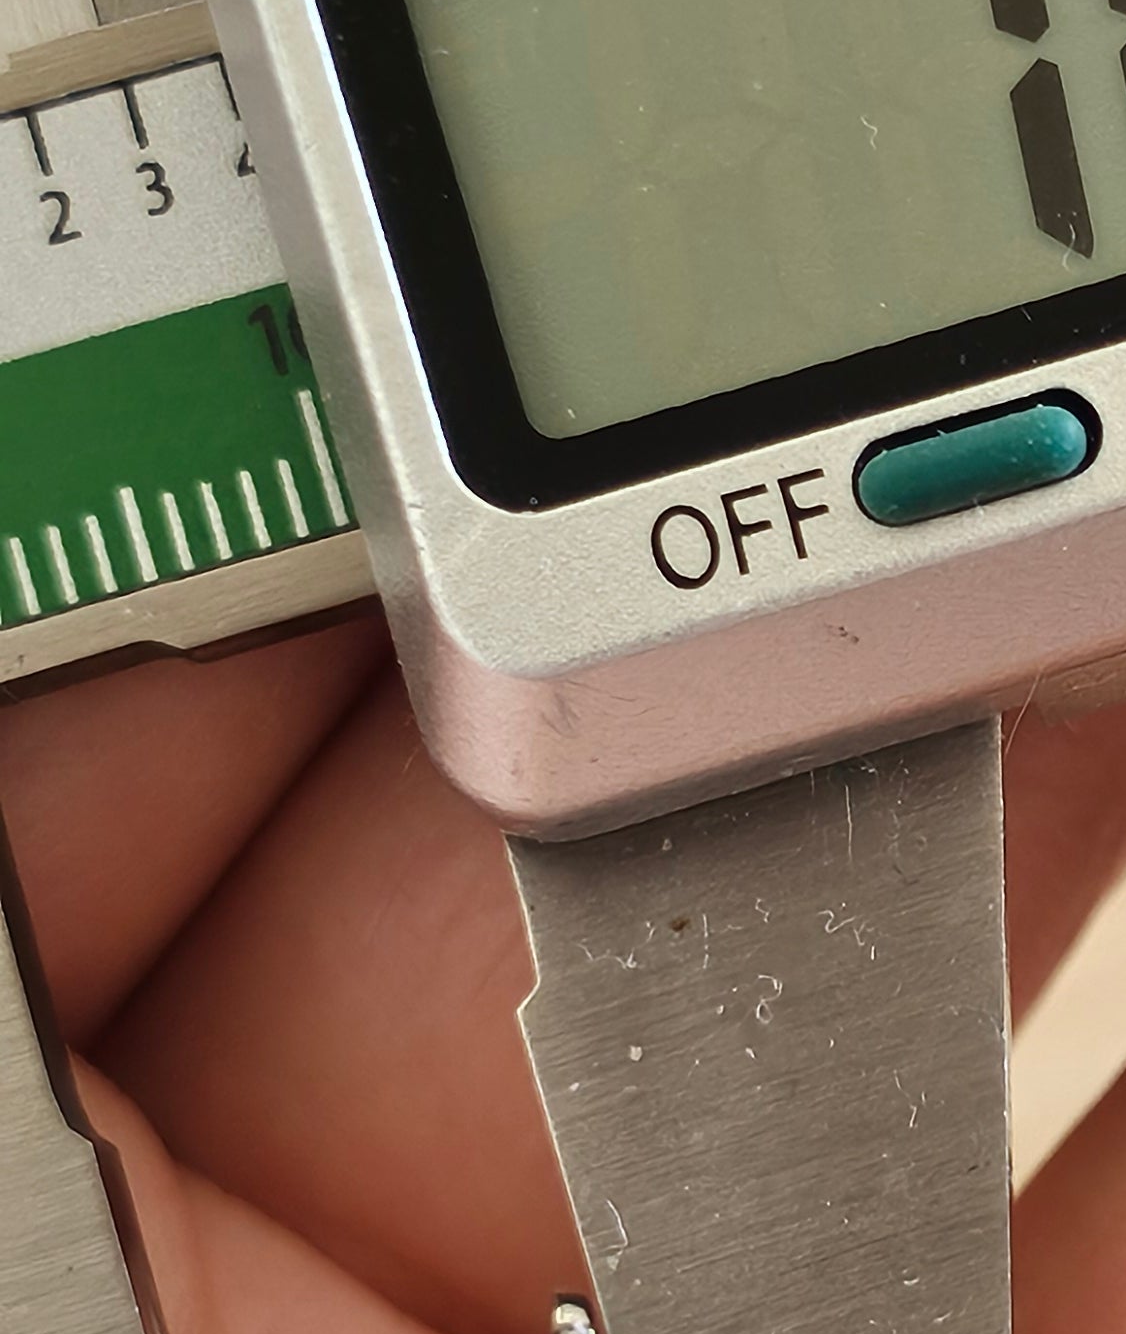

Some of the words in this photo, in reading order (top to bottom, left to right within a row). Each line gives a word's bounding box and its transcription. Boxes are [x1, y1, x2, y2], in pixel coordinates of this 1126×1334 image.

[40, 192, 81, 245] 2
[136, 163, 174, 216] 3
[651, 468, 834, 590] OFF
